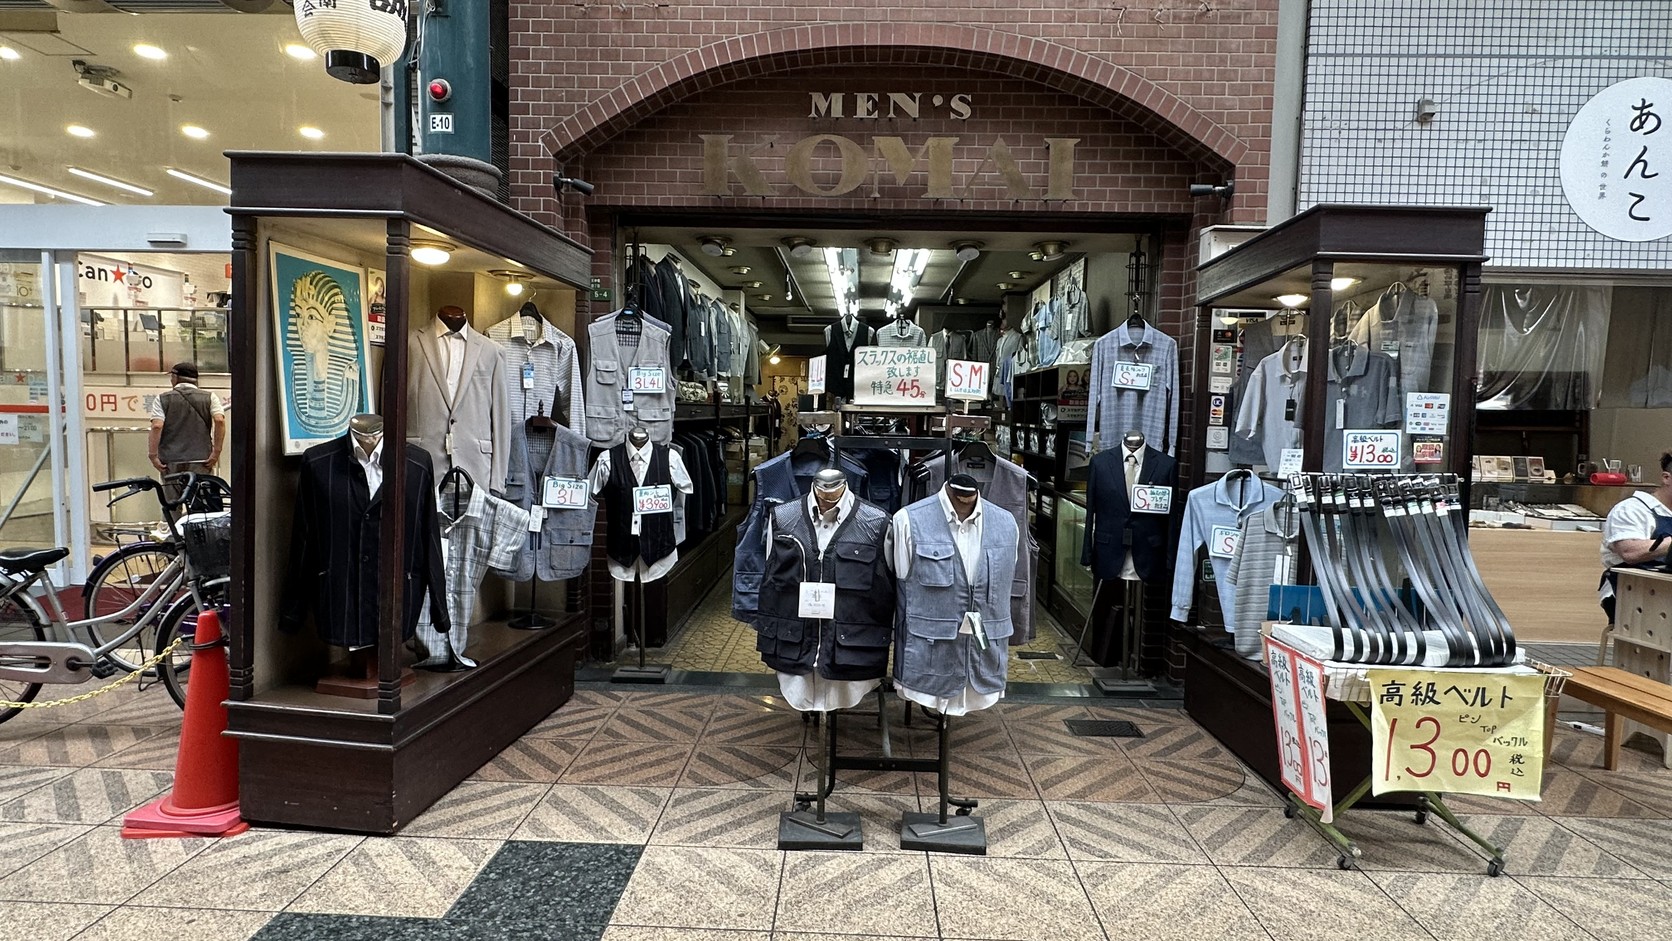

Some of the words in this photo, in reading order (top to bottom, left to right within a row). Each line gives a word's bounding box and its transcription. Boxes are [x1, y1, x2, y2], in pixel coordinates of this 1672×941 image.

[807, 92, 973, 119] MEN'S
[431, 116, 450, 130] E-10
[698, 134, 1080, 200] KOMAI
[1623, 98, 1662, 221] あんこ
[887, 365, 921, 379] 致します
[871, 380, 893, 395] 特急
[896, 378, 926, 398] 45分
[1351, 435, 1383, 443] 高級ベルト
[552, 481, 565, 489] Big
[567, 482, 584, 490] Size
[556, 488, 579, 505] 3L
[1270, 650, 1290, 673] 高級
[1273, 671, 1291, 686] ベルト
[1299, 665, 1315, 688] 高級
[1302, 687, 1319, 702] ベルト
[1379, 679, 1514, 708] 高級ベルト
[1459, 714, 1482, 724] ピン
[1492, 736, 1528, 747] バックル
[1509, 753, 1525, 777] 税込
